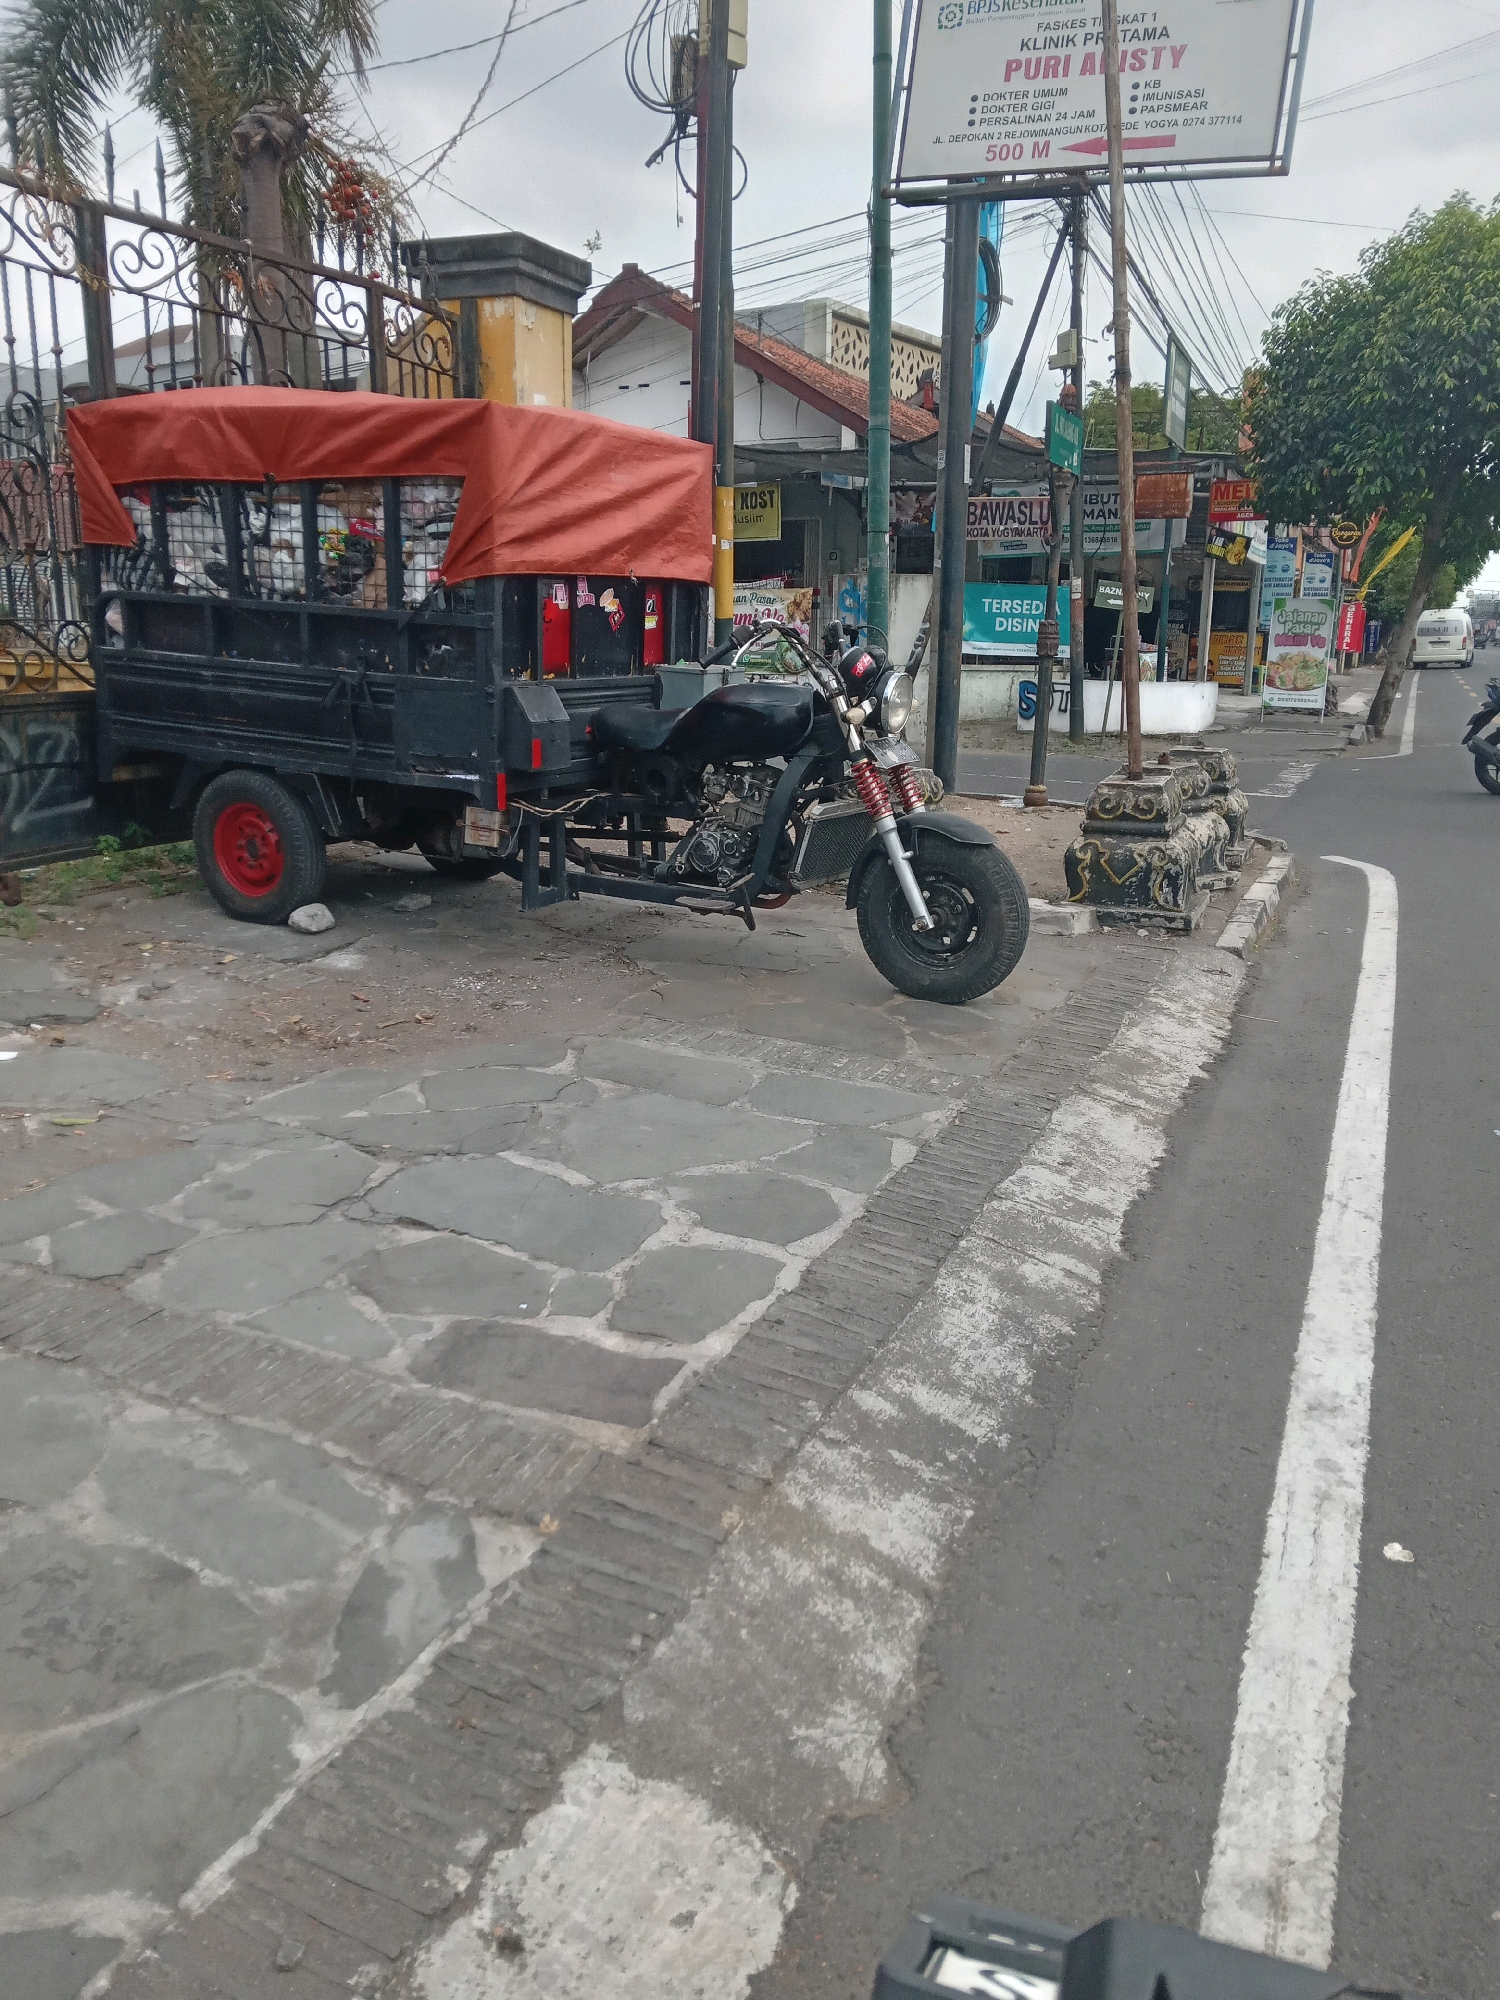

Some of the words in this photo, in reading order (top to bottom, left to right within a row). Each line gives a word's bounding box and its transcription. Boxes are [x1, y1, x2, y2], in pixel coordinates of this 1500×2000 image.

[967, 0, 1001, 15] BPJS
[1036, 17, 1088, 32] FASKES
[1091, 12, 1148, 27] TIGKAT
[1151, 12, 1158, 22] 1
[1020, 33, 1078, 52] KLINIK
[1083, 26, 1171, 46] PRTAMA
[1003, 53, 1072, 82] PURI
[1079, 44, 1188, 76] AISTY
[1144, 79, 1162, 89] KB
[982, 89, 1030, 102] DOKTER
[1033, 87, 1068, 99] UMUM
[1141, 88, 1205, 102] IMUNISASI
[980, 102, 1028, 115] DOKTER
[1031, 100, 1055, 111] GIGI
[1140, 100, 1209, 115] PAPSMEAR
[979, 113, 1052, 127] PERSALINAN
[1055, 112, 1068, 121] 24
[1070, 109, 1096, 120] JAM
[932, 136, 946, 144] JL.
[948, 132, 995, 143] DEPOKAN
[996, 131, 1003, 140] 2
[1003, 124, 1083, 140] REJOWINANGUN
[1084, 121, 1139, 133] KOTAEDE
[1144, 118, 1179, 129] YOGYA
[1182, 117, 1206, 127] 0274
[1208, 115, 1243, 126] 377114
[984, 143, 1024, 162] 500
[1031, 140, 1051, 159] M
[740, 489, 775, 511] KOST
[1083, 493, 1120, 505] IBUT
[966, 501, 1051, 526] BAWASLU
[966, 527, 990, 538] KOTA
[991, 527, 1049, 538] YOGYAKARTA
[750, 592, 777, 606] Pasar
[982, 598, 1061, 615] TERSEDA
[995, 617, 1041, 633] DISIN
[1277, 609, 1328, 625] Jajanan
[1284, 622, 1320, 635] Pasar
[1342, 604, 1356, 650] GENERAL
